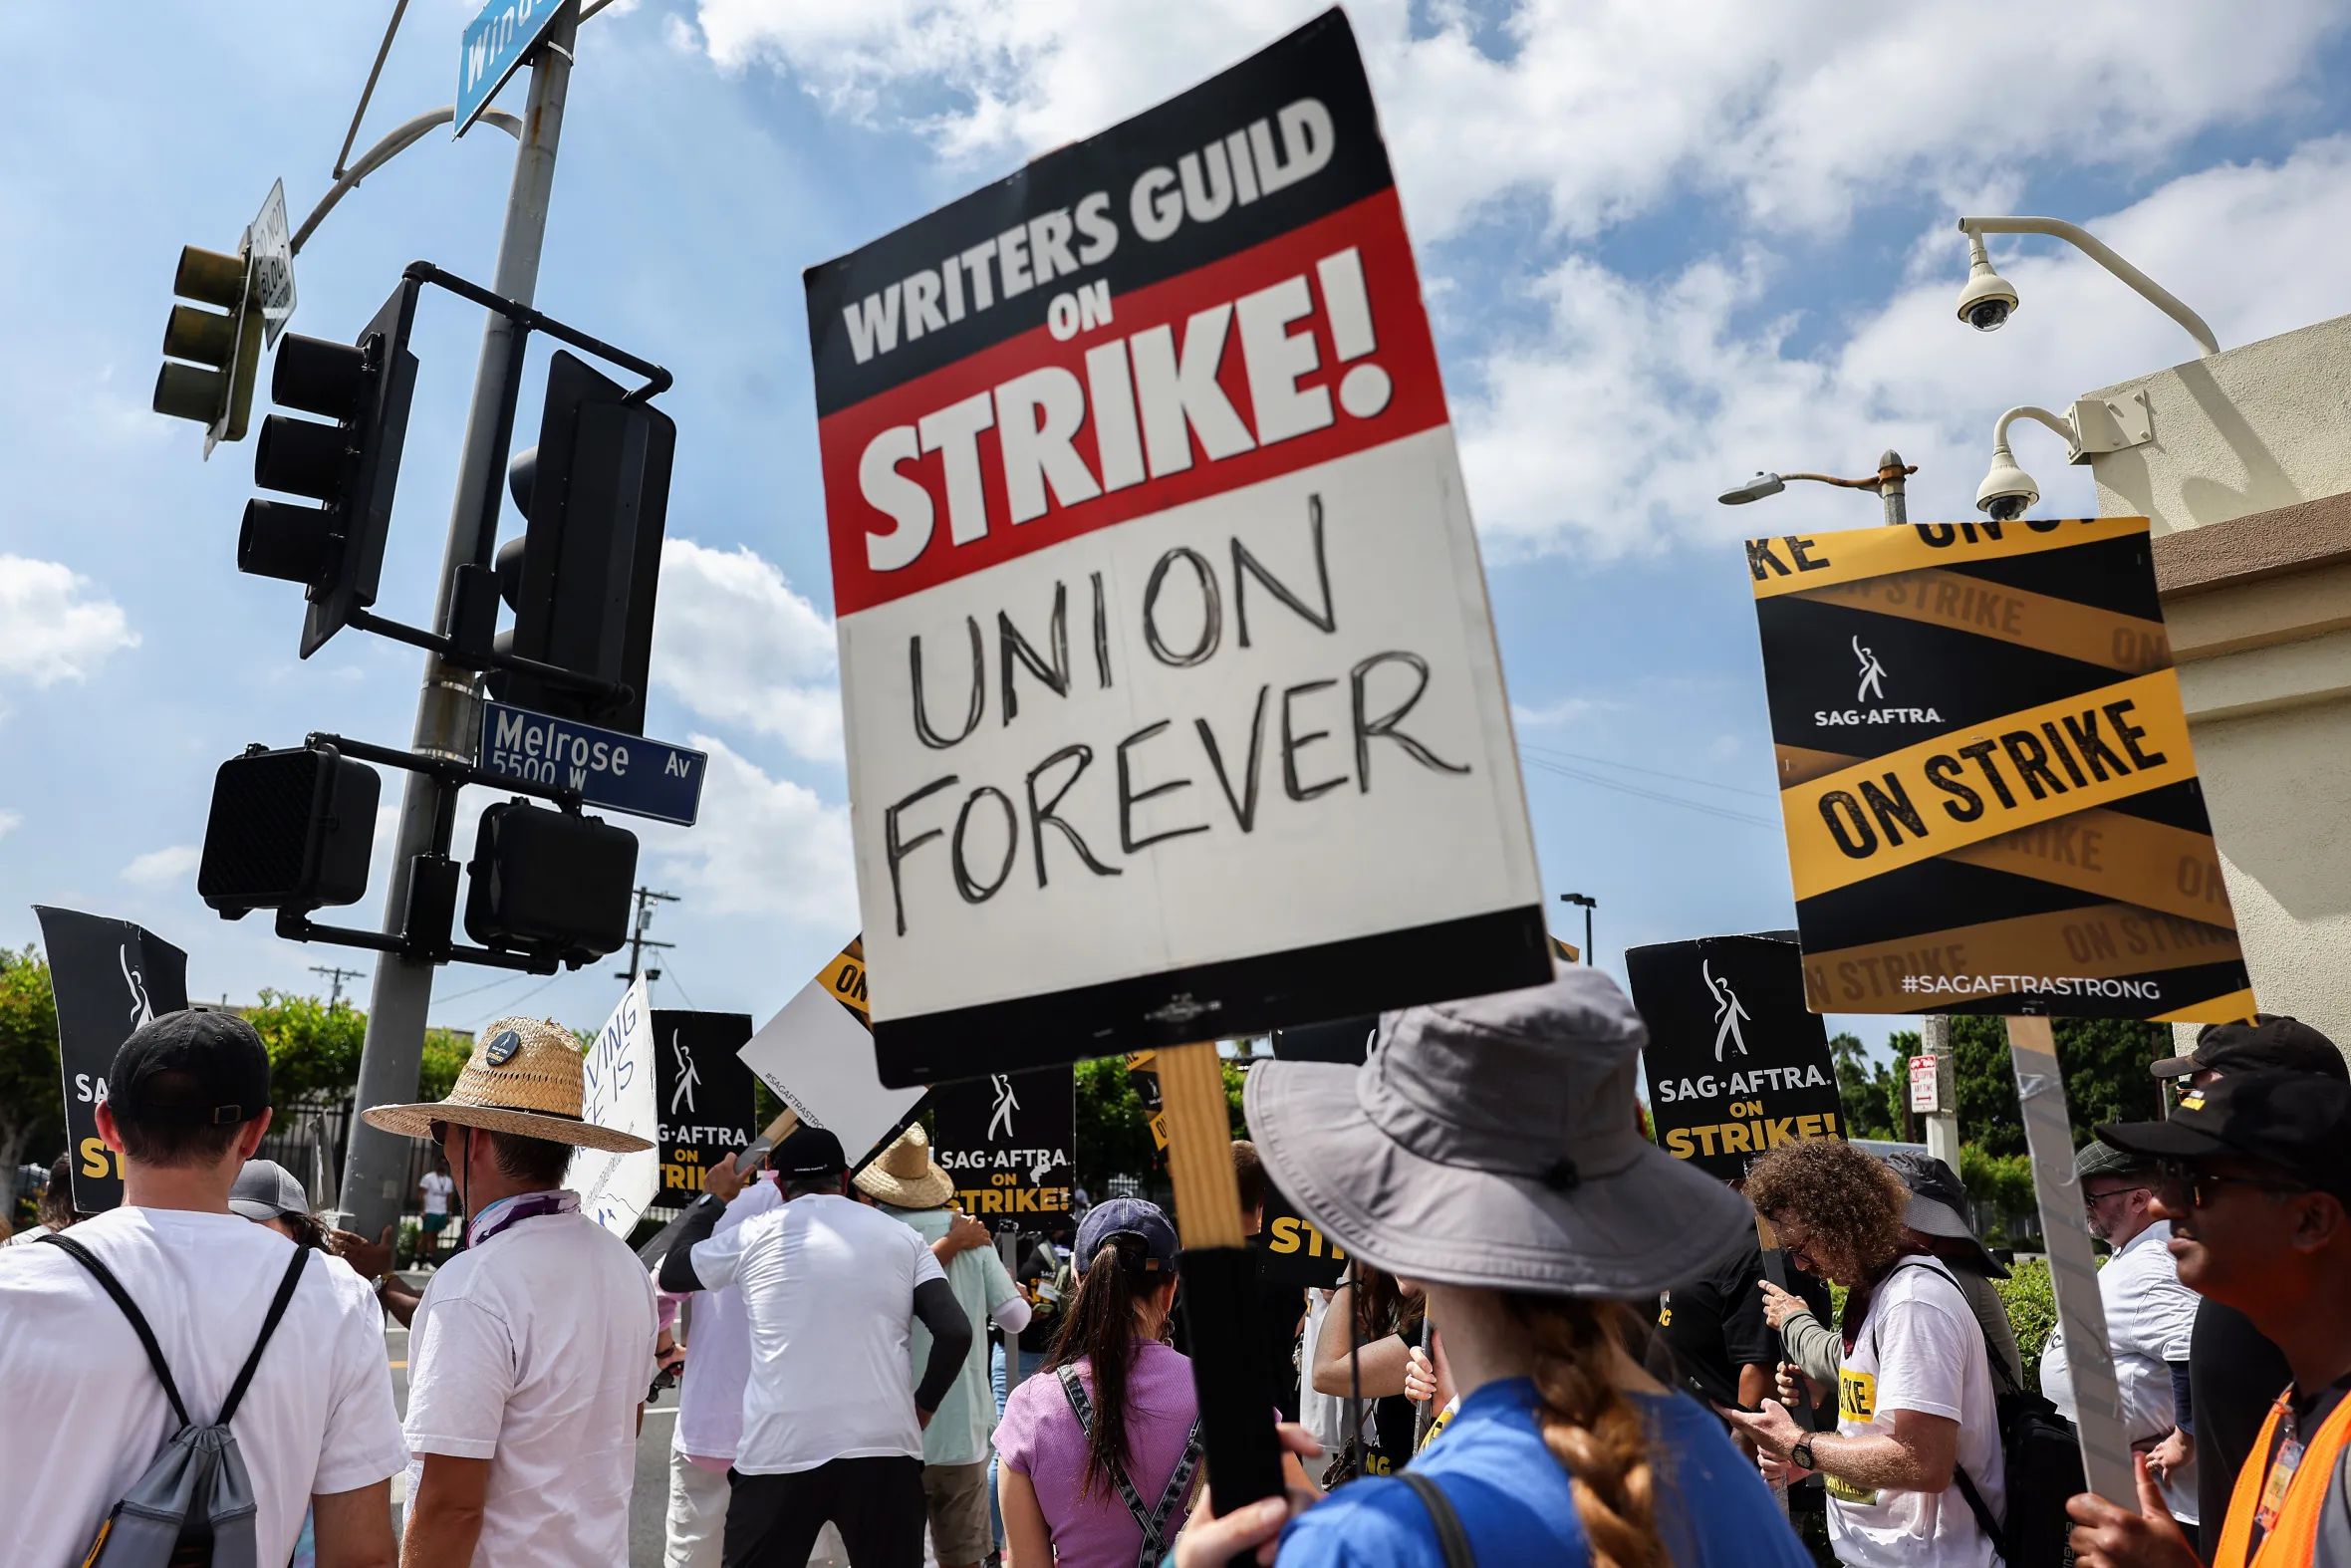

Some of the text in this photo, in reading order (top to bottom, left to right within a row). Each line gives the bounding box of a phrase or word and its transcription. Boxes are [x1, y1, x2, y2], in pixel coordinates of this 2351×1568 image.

[267, 199, 284, 243] NOT
[843, 97, 1335, 366] WRITERS GUILD
[1047, 279, 1113, 342] ON
[859, 246, 1393, 572] STRIKE!
[909, 493, 1336, 750] UNION
[492, 750, 587, 791] 5500 W
[495, 710, 690, 778] Melrose Av
[885, 651, 1470, 935] FOREVER
[1818, 699, 2168, 860] ON STRIKE
[1902, 973, 2160, 1000] #SAGAFTRASTRONG
[614, 1042, 634, 1102] IS
[765, 1073, 827, 1132] #SAGAFTRASTRO
[1729, 1100, 1763, 1118] ON
[674, 1149, 698, 1163] ON
[1666, 1113, 1839, 1160] STRIKE!
[991, 1173, 1017, 1185] ON
